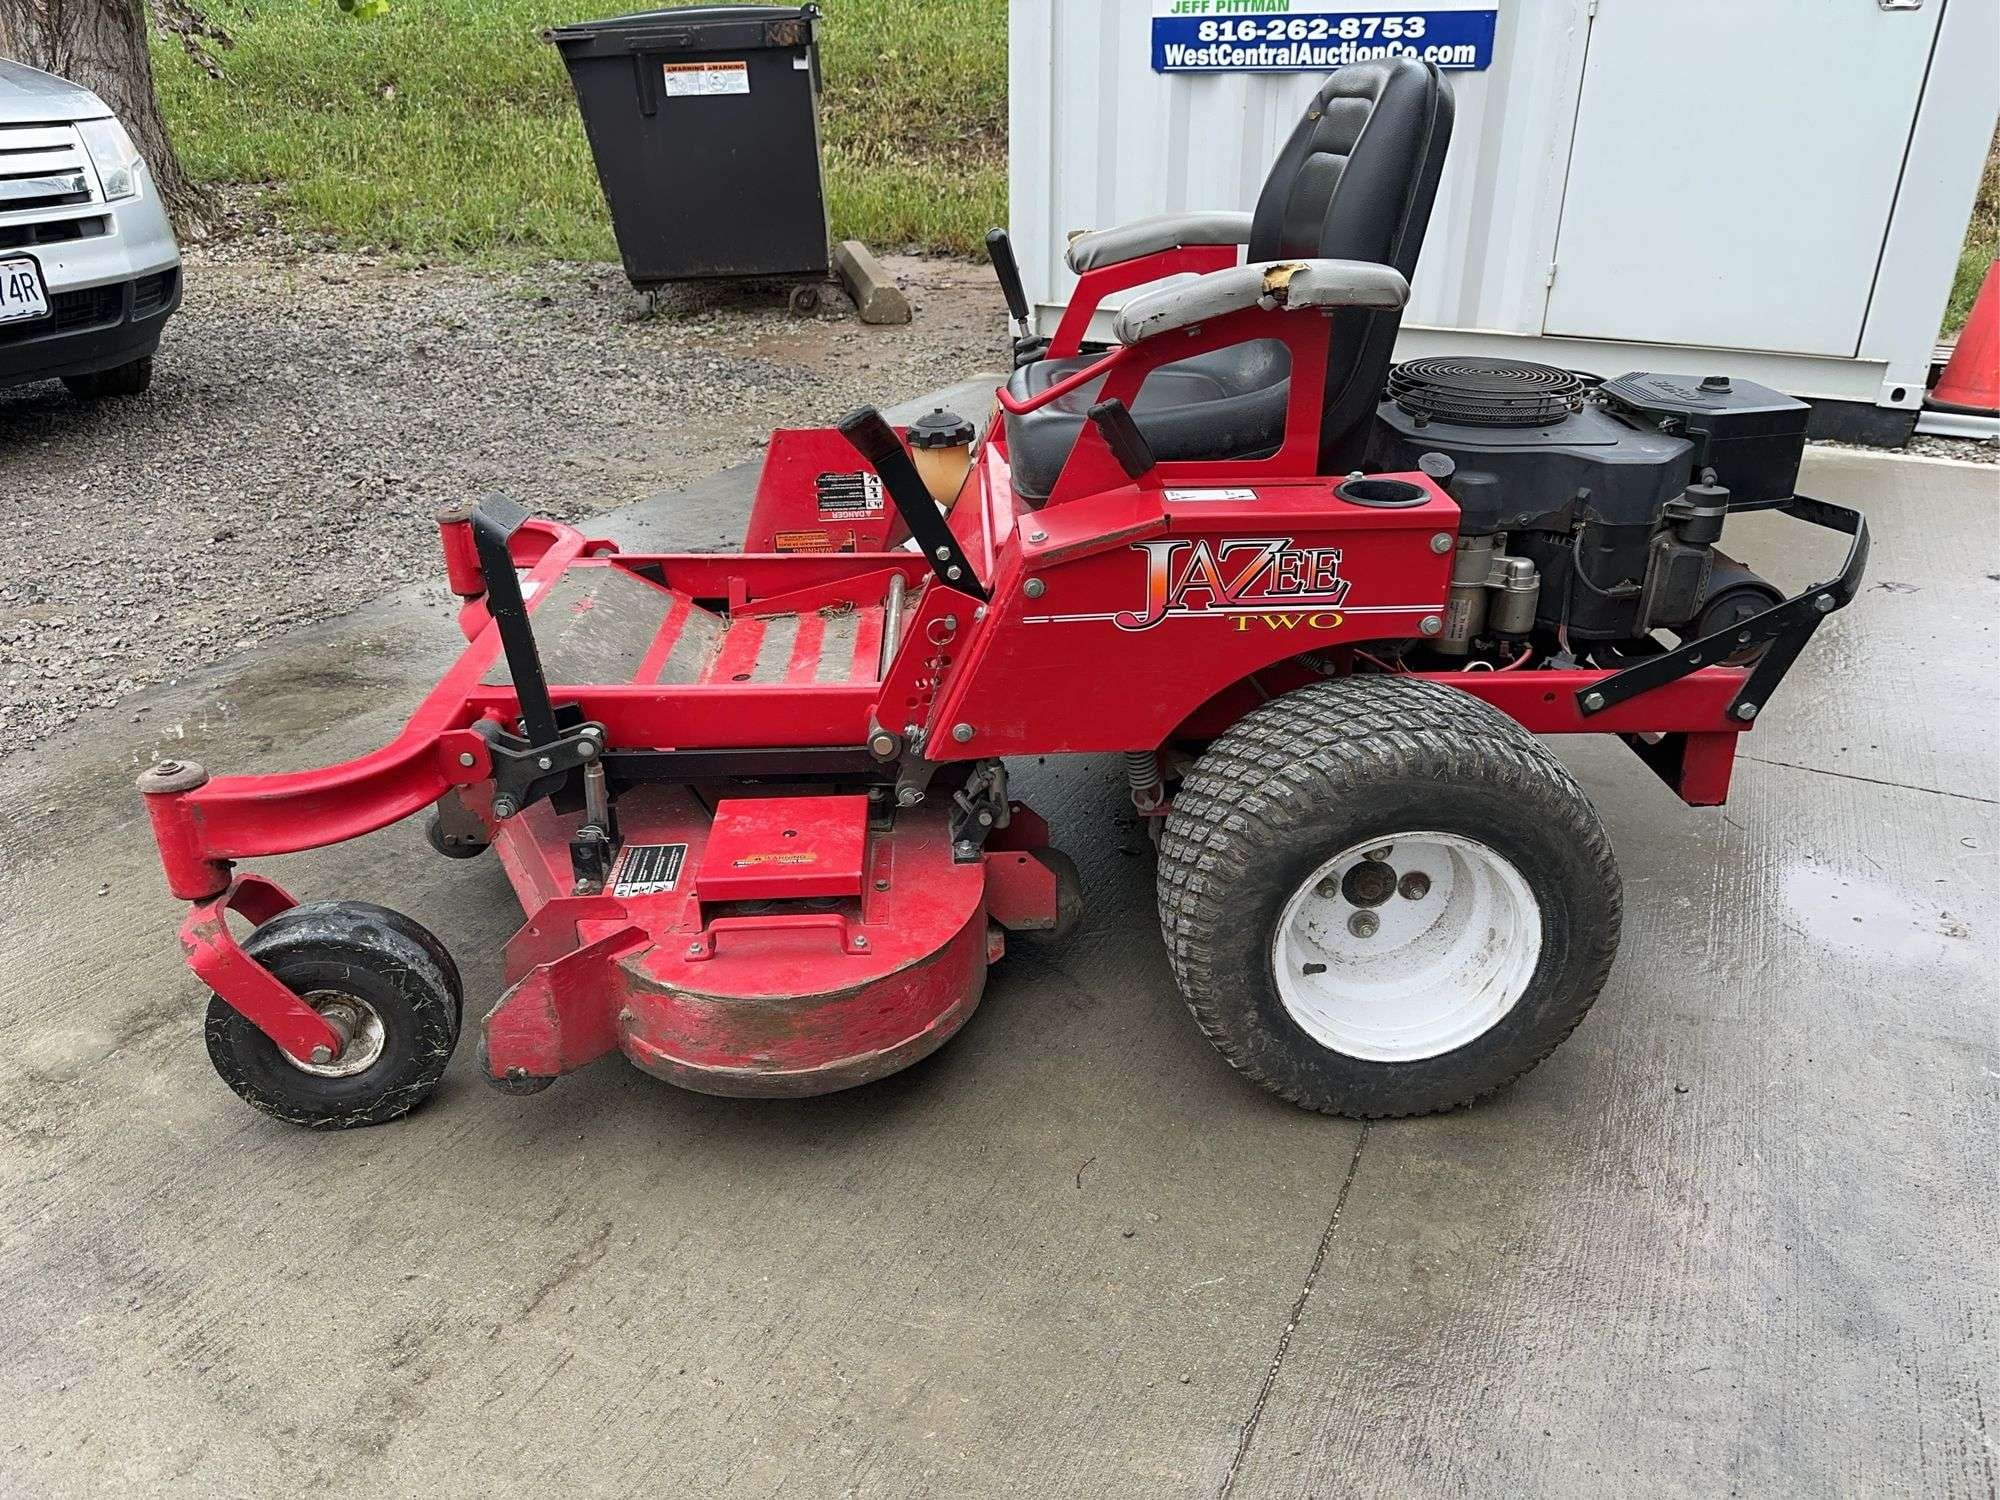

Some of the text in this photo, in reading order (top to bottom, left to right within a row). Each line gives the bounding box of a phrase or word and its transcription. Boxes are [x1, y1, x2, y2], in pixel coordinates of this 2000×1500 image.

[1171, 0, 1290, 14] JEFF PITTMAN
[1198, 16, 1426, 41] 816-262-8753
[1164, 40, 1476, 66] WestCentralAuctionCo.com
[1229, 612, 1344, 631] TWO
